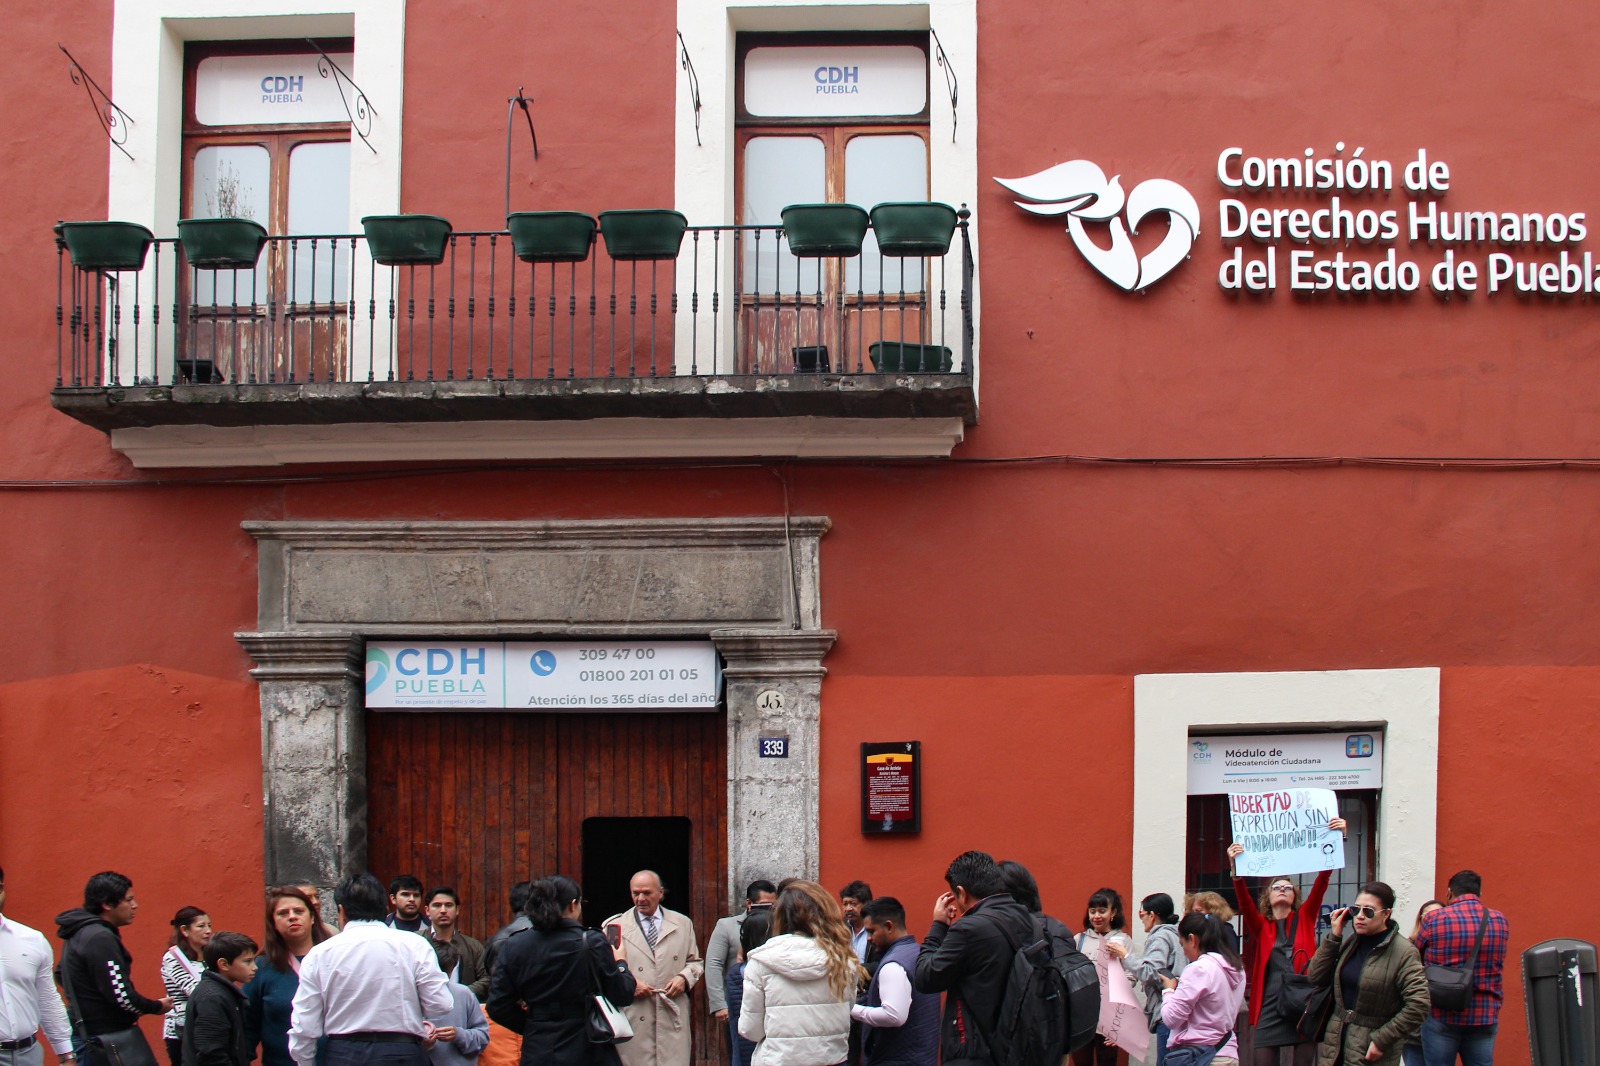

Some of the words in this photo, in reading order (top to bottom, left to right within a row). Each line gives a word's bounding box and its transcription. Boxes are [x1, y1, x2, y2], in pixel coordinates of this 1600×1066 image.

[814, 66, 859, 84] CDH
[261, 76, 304, 93] CDH
[816, 85, 859, 94] PUEBLA
[262, 94, 303, 103] PUEBLA
[1217, 141, 1393, 190] Comisión
[1403, 148, 1450, 191] de
[1219, 196, 1399, 240] Derechos
[1408, 201, 1587, 243] Humanos
[1219, 247, 1276, 290] del
[1290, 248, 1420, 292] Estado
[1431, 249, 1477, 291] de
[395, 648, 486, 675] CDH
[579, 649, 608, 661] 309
[612, 648, 630, 660] 47
[635, 648, 656, 660] 00
[579, 670, 625, 682] 01800
[629, 669, 655, 682] 201
[658, 669, 674, 681] 01
[679, 668, 698, 681] 05
[395, 679, 486, 693] PUEBLA
[528, 694, 587, 706] Atención
[590, 694, 609, 705] los
[612, 694, 635, 705] 365
[638, 693, 664, 705] días
[668, 693, 693, 704] del
[695, 693, 716, 704] año
[764, 740, 783, 755] 339
[1225, 748, 1266, 758] Módulo
[1269, 748, 1283, 757] de
[1225, 759, 1279, 767] Videoatención
[1281, 758, 1322, 766] Ciudadana
[1231, 791, 1292, 815] LIBERTAD
[1296, 790, 1313, 810] DE
[1232, 810, 1299, 834] EXPRESIÓN
[1305, 807, 1330, 825] SIN
